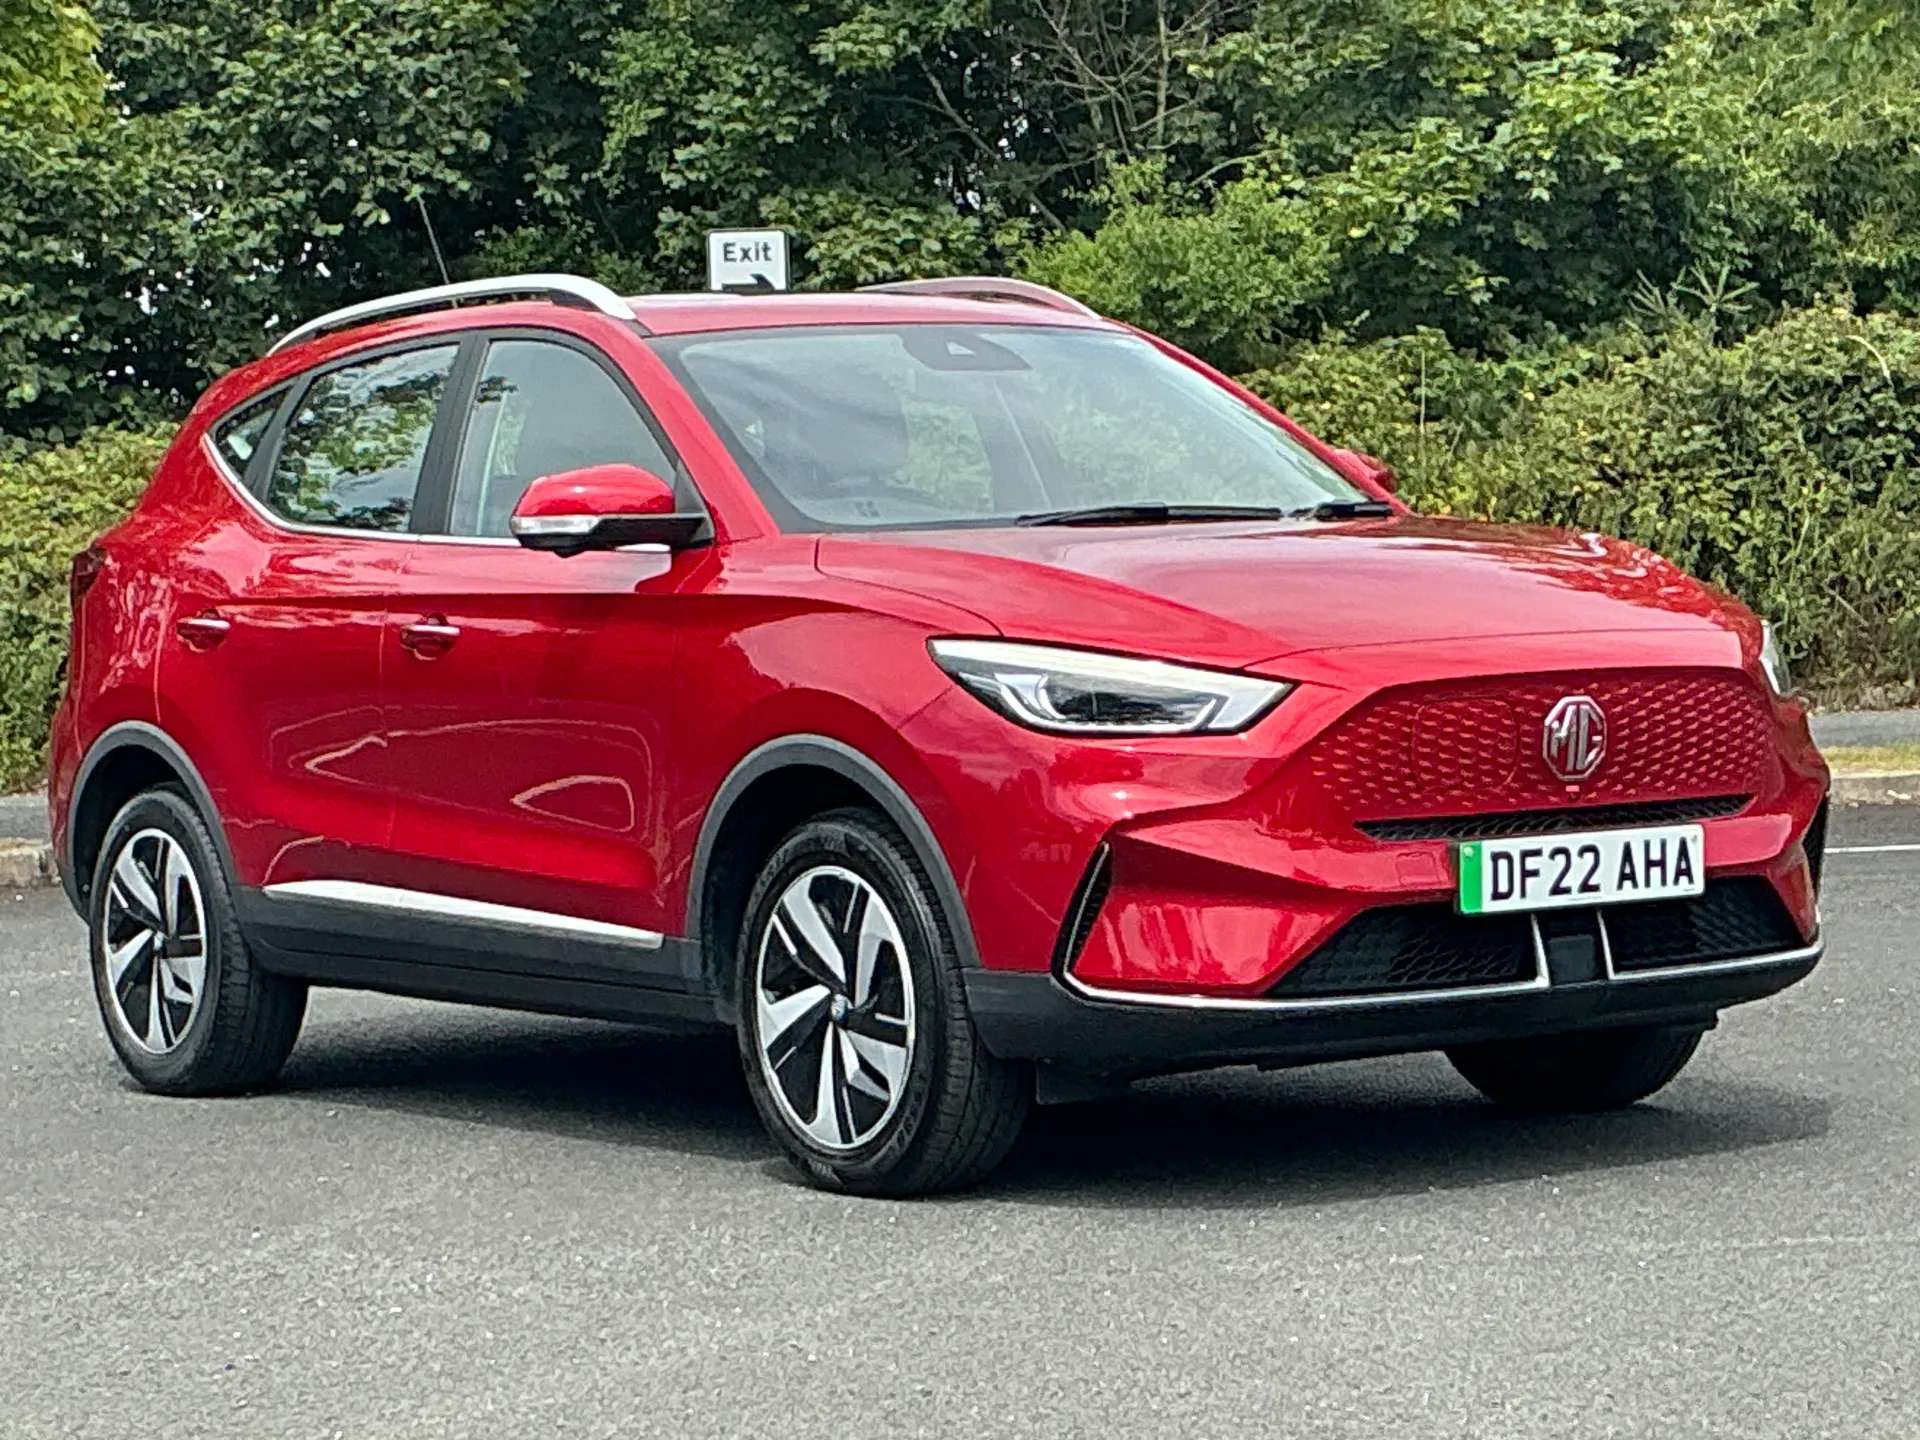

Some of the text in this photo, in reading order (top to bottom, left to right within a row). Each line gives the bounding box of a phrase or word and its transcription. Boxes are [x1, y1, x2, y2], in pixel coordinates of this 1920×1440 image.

[723, 242, 772, 262] Exit
[1550, 704, 1603, 771] MG
[1490, 836, 1695, 901] DF22 AHA
